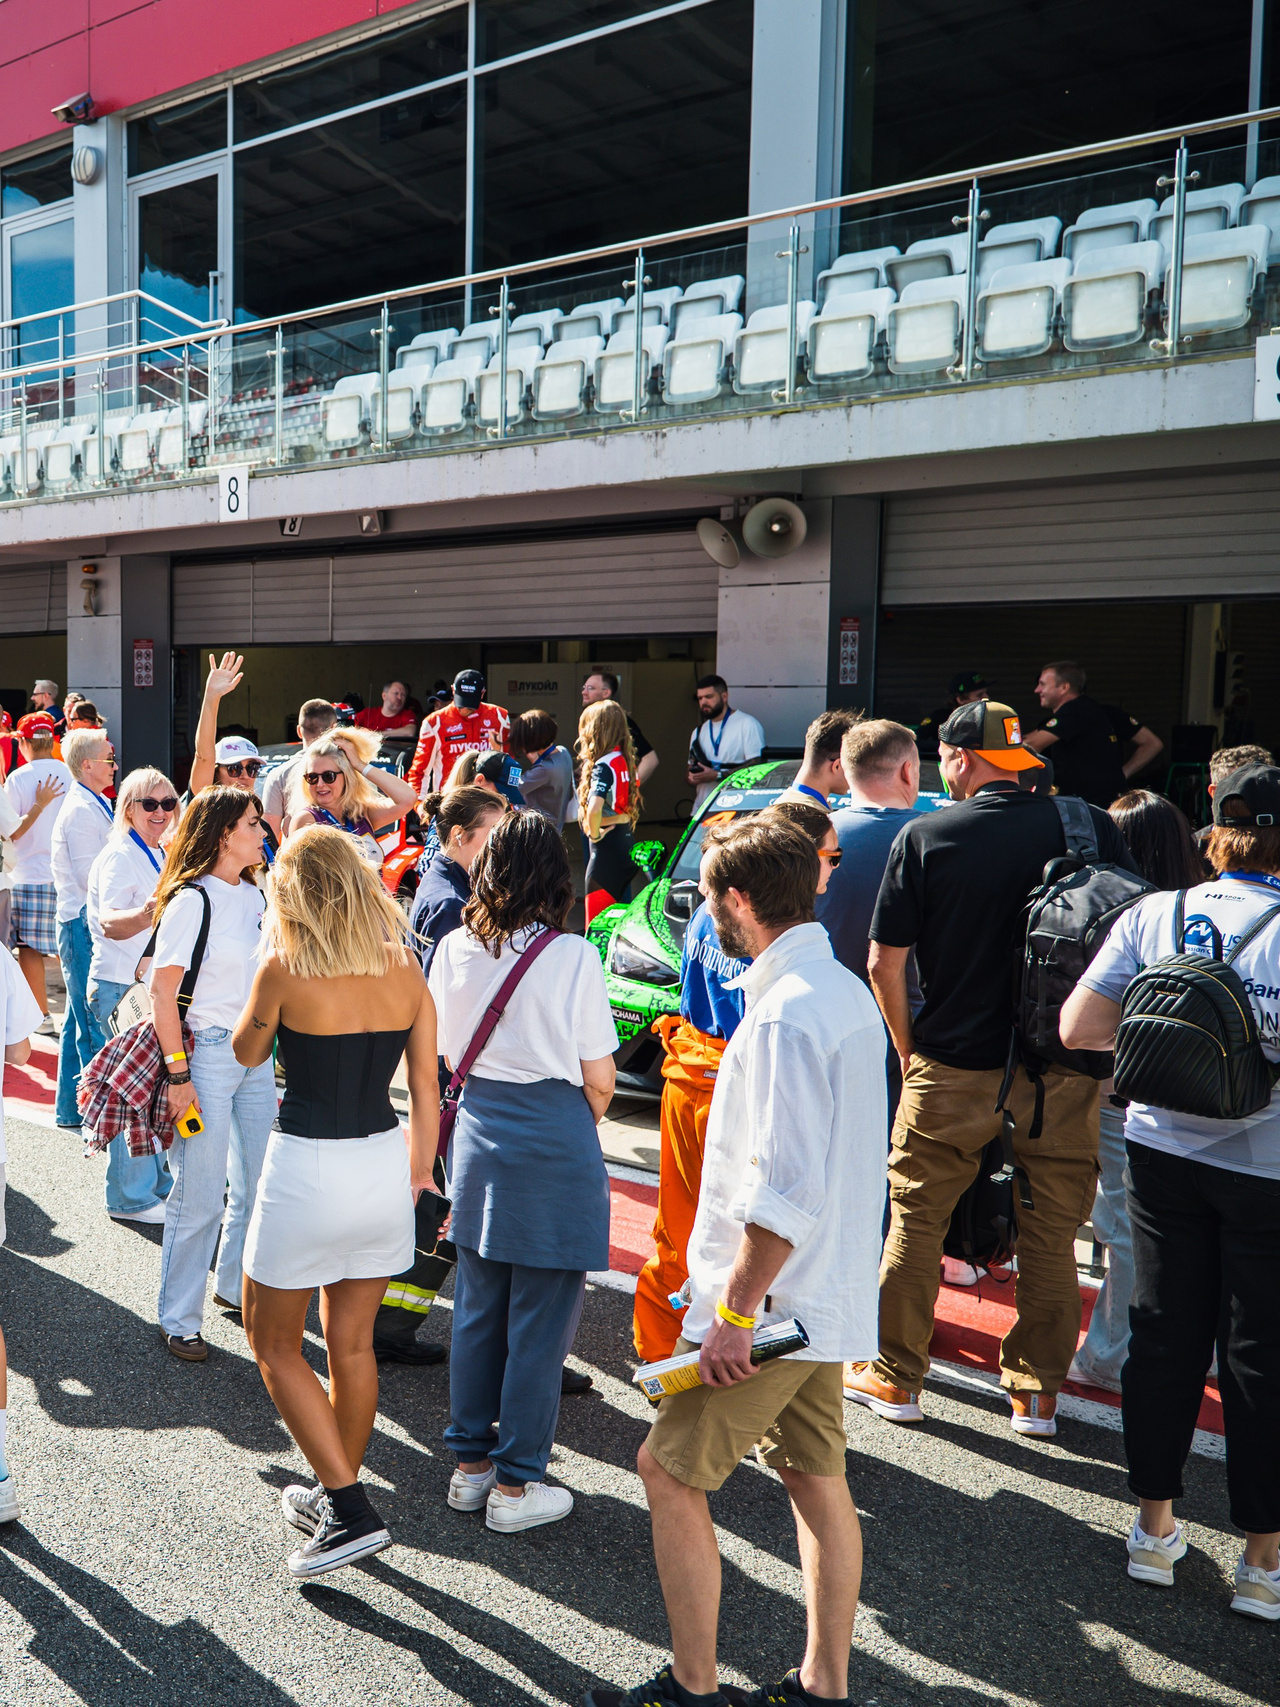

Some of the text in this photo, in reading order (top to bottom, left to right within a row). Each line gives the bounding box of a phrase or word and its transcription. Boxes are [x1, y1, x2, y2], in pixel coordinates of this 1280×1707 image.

[227, 476, 239, 513] 8
[289, 518, 298, 532] 8
[518, 680, 558, 691] ЛУКОЙЛ
[129, 995, 143, 1020] BURB
